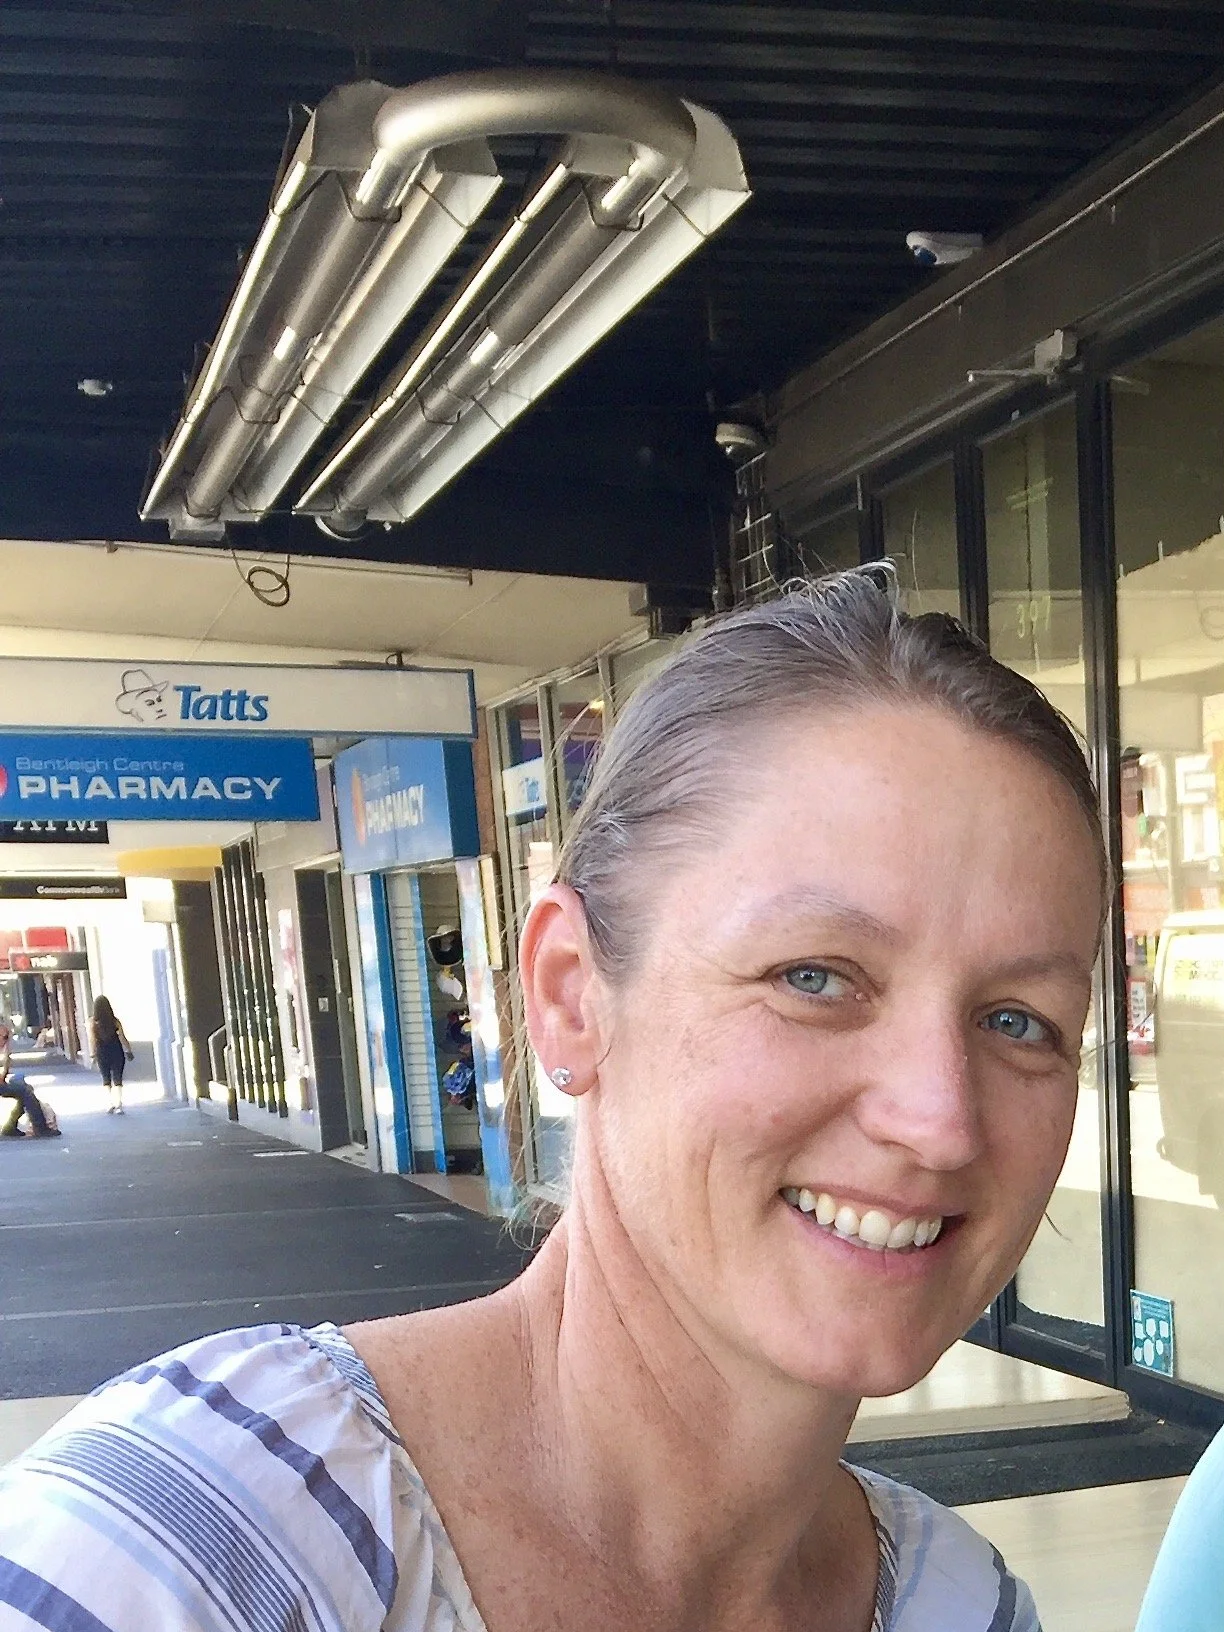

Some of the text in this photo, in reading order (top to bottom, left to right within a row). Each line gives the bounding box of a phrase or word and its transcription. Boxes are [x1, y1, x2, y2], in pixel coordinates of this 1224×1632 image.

[173, 685, 269, 722] Tatts
[15, 756, 184, 772] Bentleigh Centre
[18, 775, 282, 800] PHARMACY
